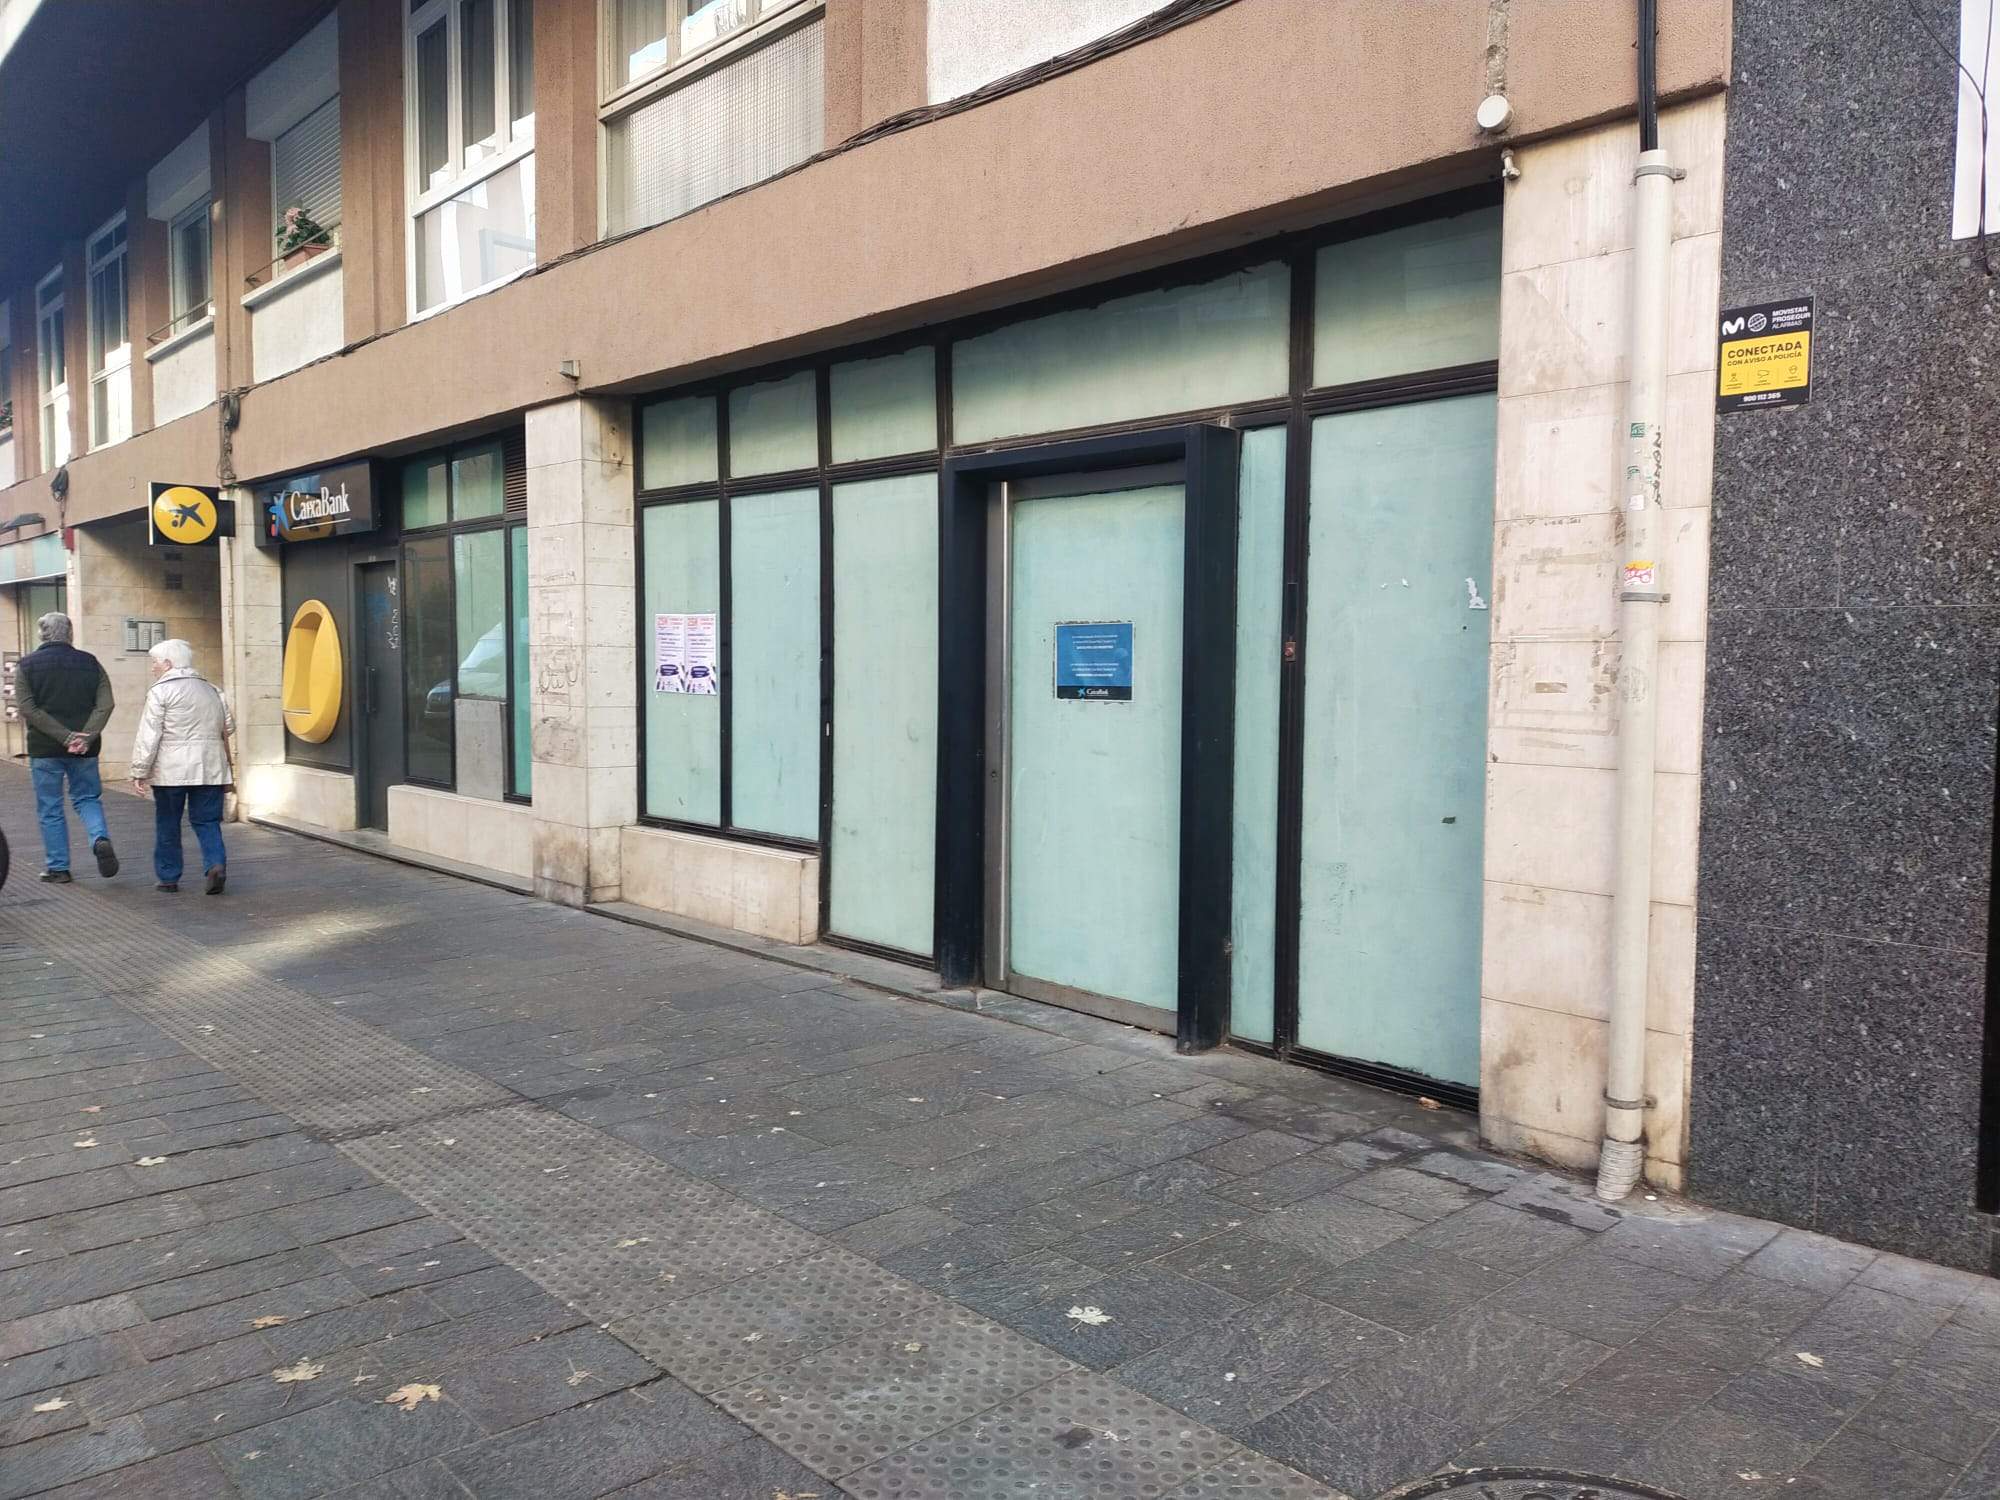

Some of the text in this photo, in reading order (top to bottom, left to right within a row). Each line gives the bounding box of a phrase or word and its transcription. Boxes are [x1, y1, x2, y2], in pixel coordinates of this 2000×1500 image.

[1772, 306, 1808, 316] MOVISTAR
[1772, 312, 1811, 323] PROSEGUR
[1727, 341, 1802, 359] CONECTADA
[1744, 356, 1765, 364] AVISO
[1773, 351, 1802, 360] POLICÍA
[290, 482, 351, 520] CaixaBank
